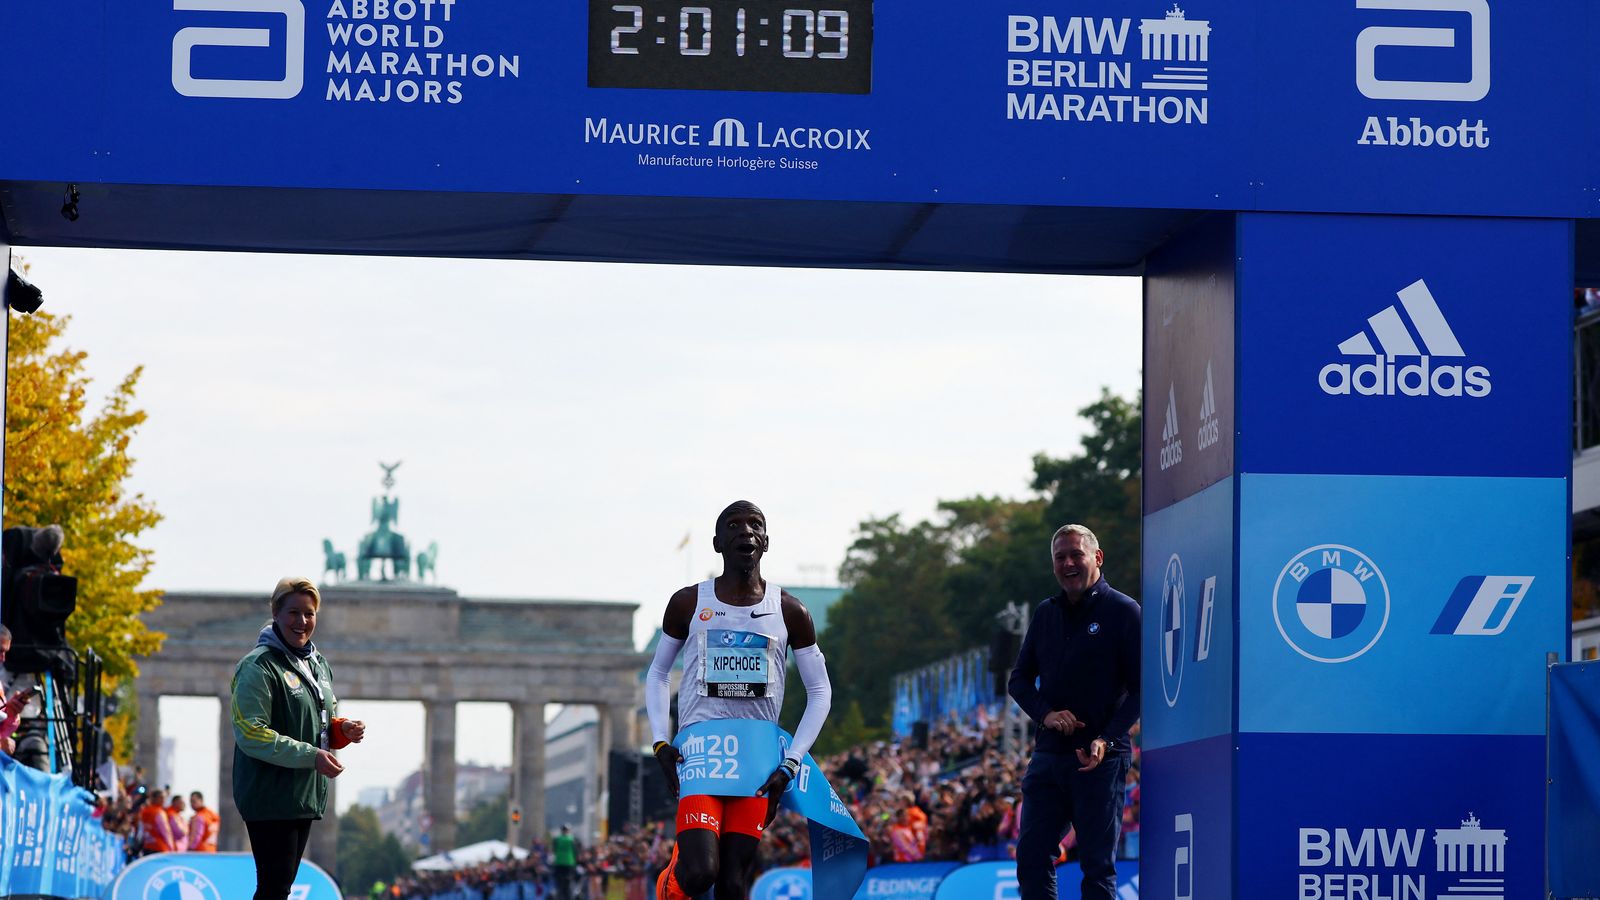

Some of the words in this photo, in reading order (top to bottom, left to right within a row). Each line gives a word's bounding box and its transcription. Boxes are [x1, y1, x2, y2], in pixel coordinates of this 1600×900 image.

[327, 0, 452, 21] ABBOTT
[327, 23, 444, 48] WORLD
[1007, 15, 1131, 55] BMW
[326, 50, 519, 78] MARATHON
[1007, 60, 1131, 89] BERLIN
[326, 78, 463, 104] MAJORS
[1006, 93, 1208, 125] MARATHON
[585, 117, 700, 146] MAURICE
[757, 122, 871, 150] LACROIX
[1357, 116, 1490, 148] Abbott
[638, 154, 713, 167] Manufacture
[717, 156, 776, 171] Horlogère
[779, 157, 818, 170] Suisse
[1318, 354, 1492, 398] adidas
[1160, 436, 1183, 471] adidas
[1289, 550, 1375, 582] BMW
[713, 656, 761, 671] KIPCHOGE
[717, 683, 749, 691] IMPOSSIBLE
[706, 735, 739, 757] 20
[708, 758, 740, 780] 22
[1299, 828, 1426, 867] BMW
[1299, 873, 1426, 900] BERLIN
